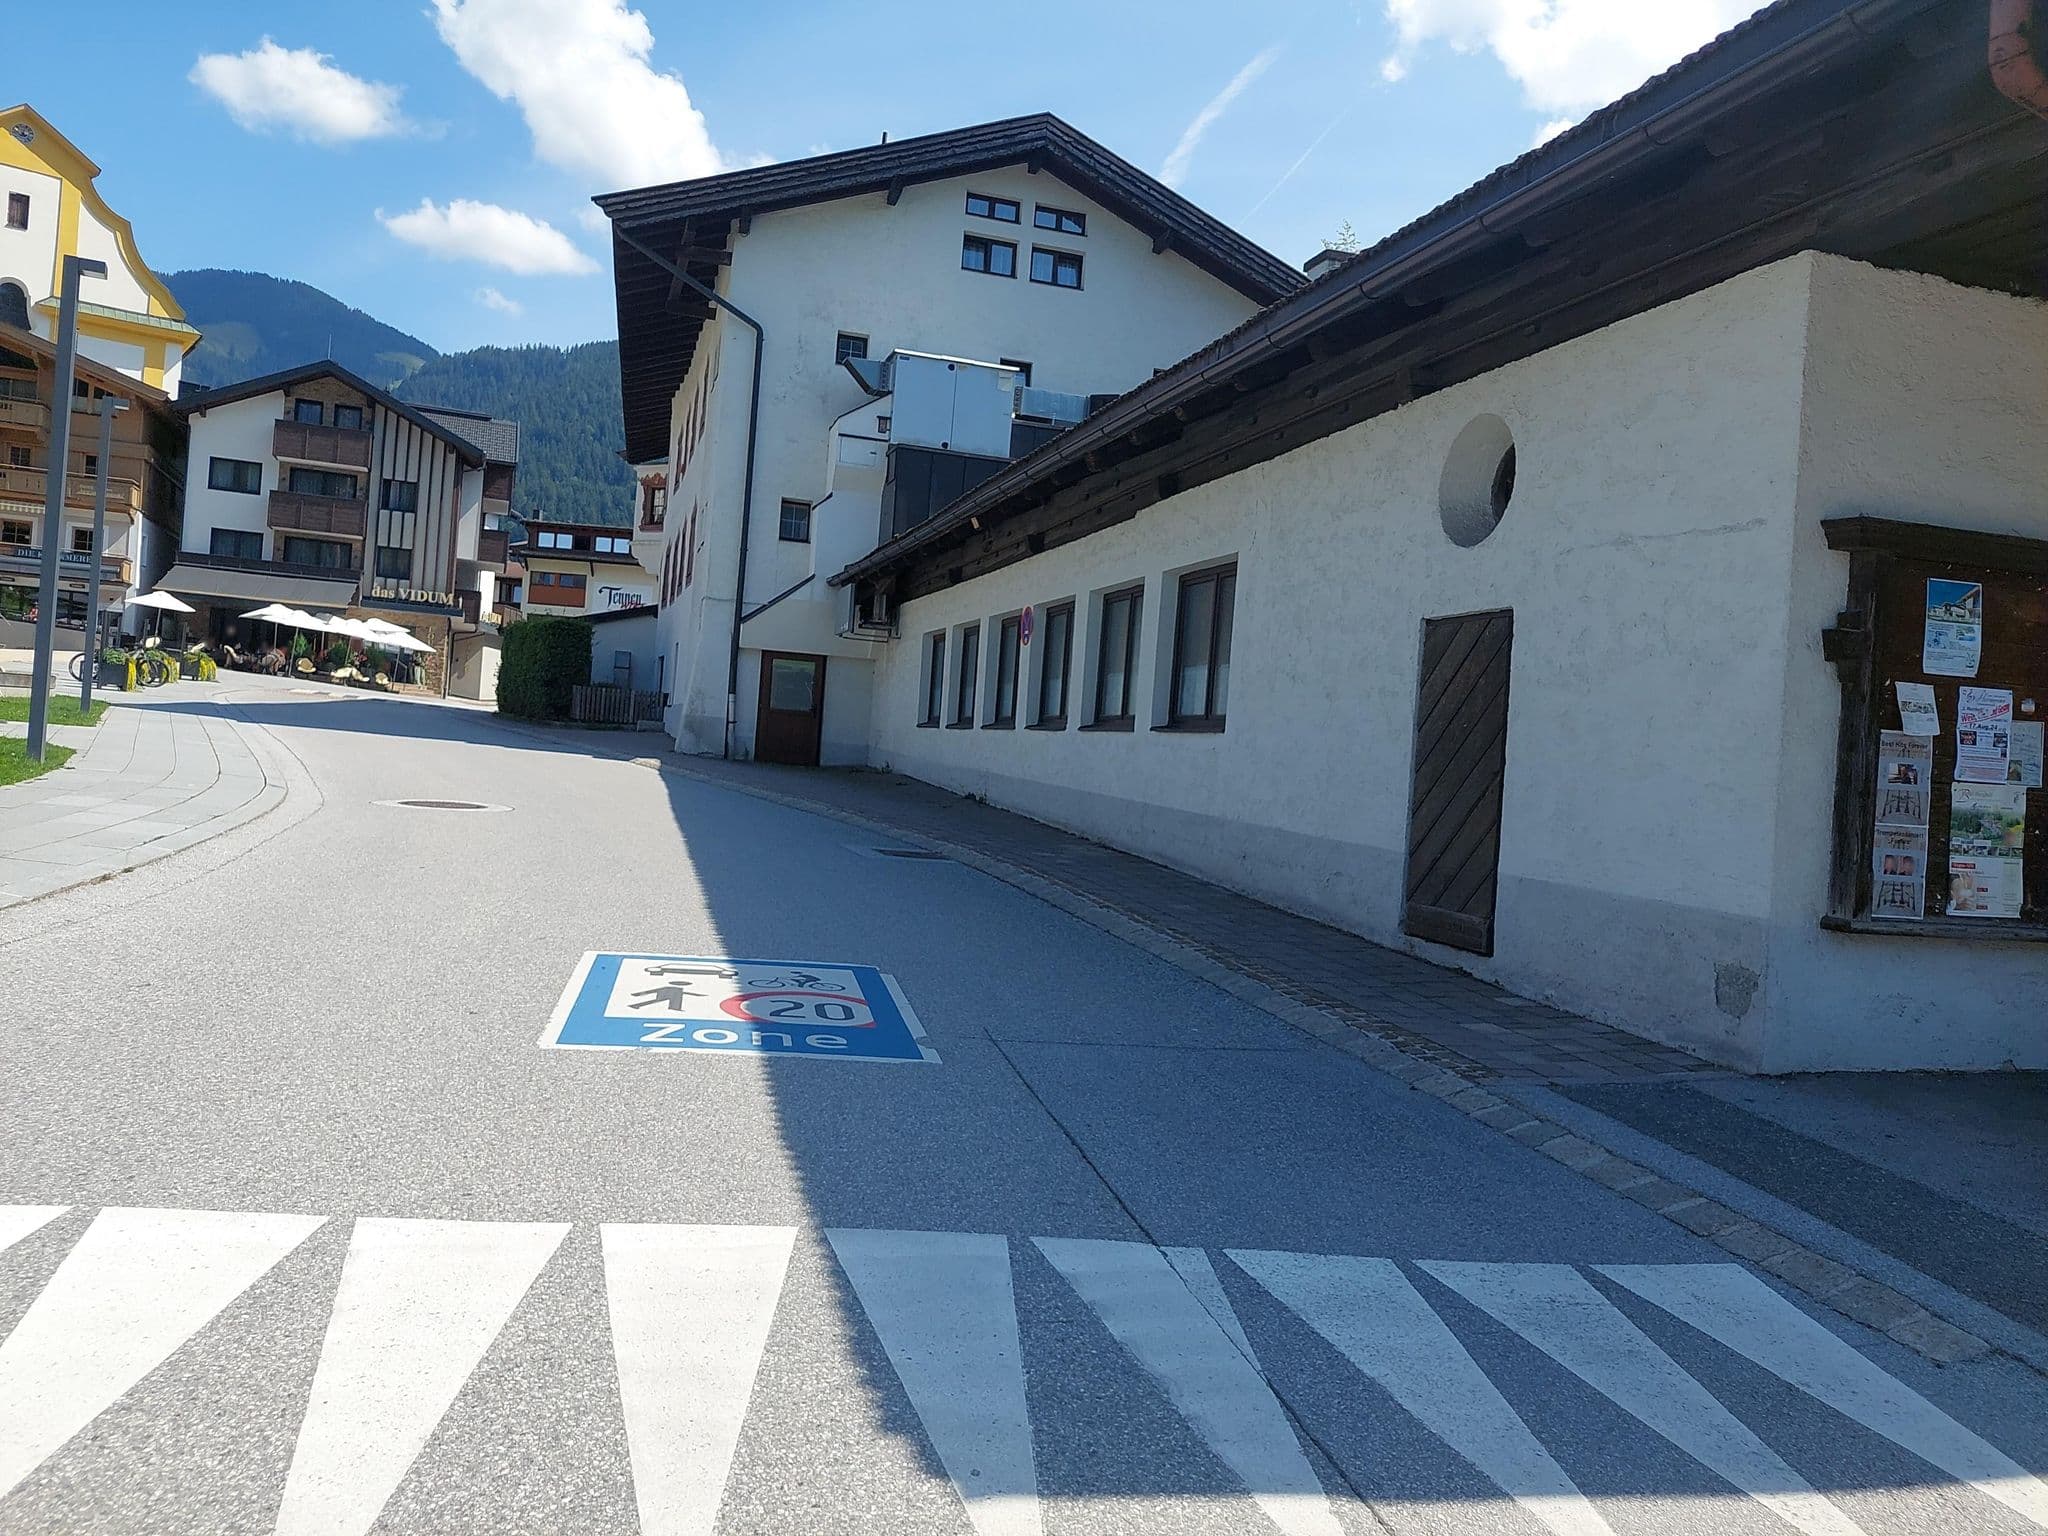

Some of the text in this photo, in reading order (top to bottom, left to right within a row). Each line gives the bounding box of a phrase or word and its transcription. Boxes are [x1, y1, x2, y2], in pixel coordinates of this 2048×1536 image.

[371, 585, 455, 607] das VIDUM
[768, 1000, 856, 1022] 20
